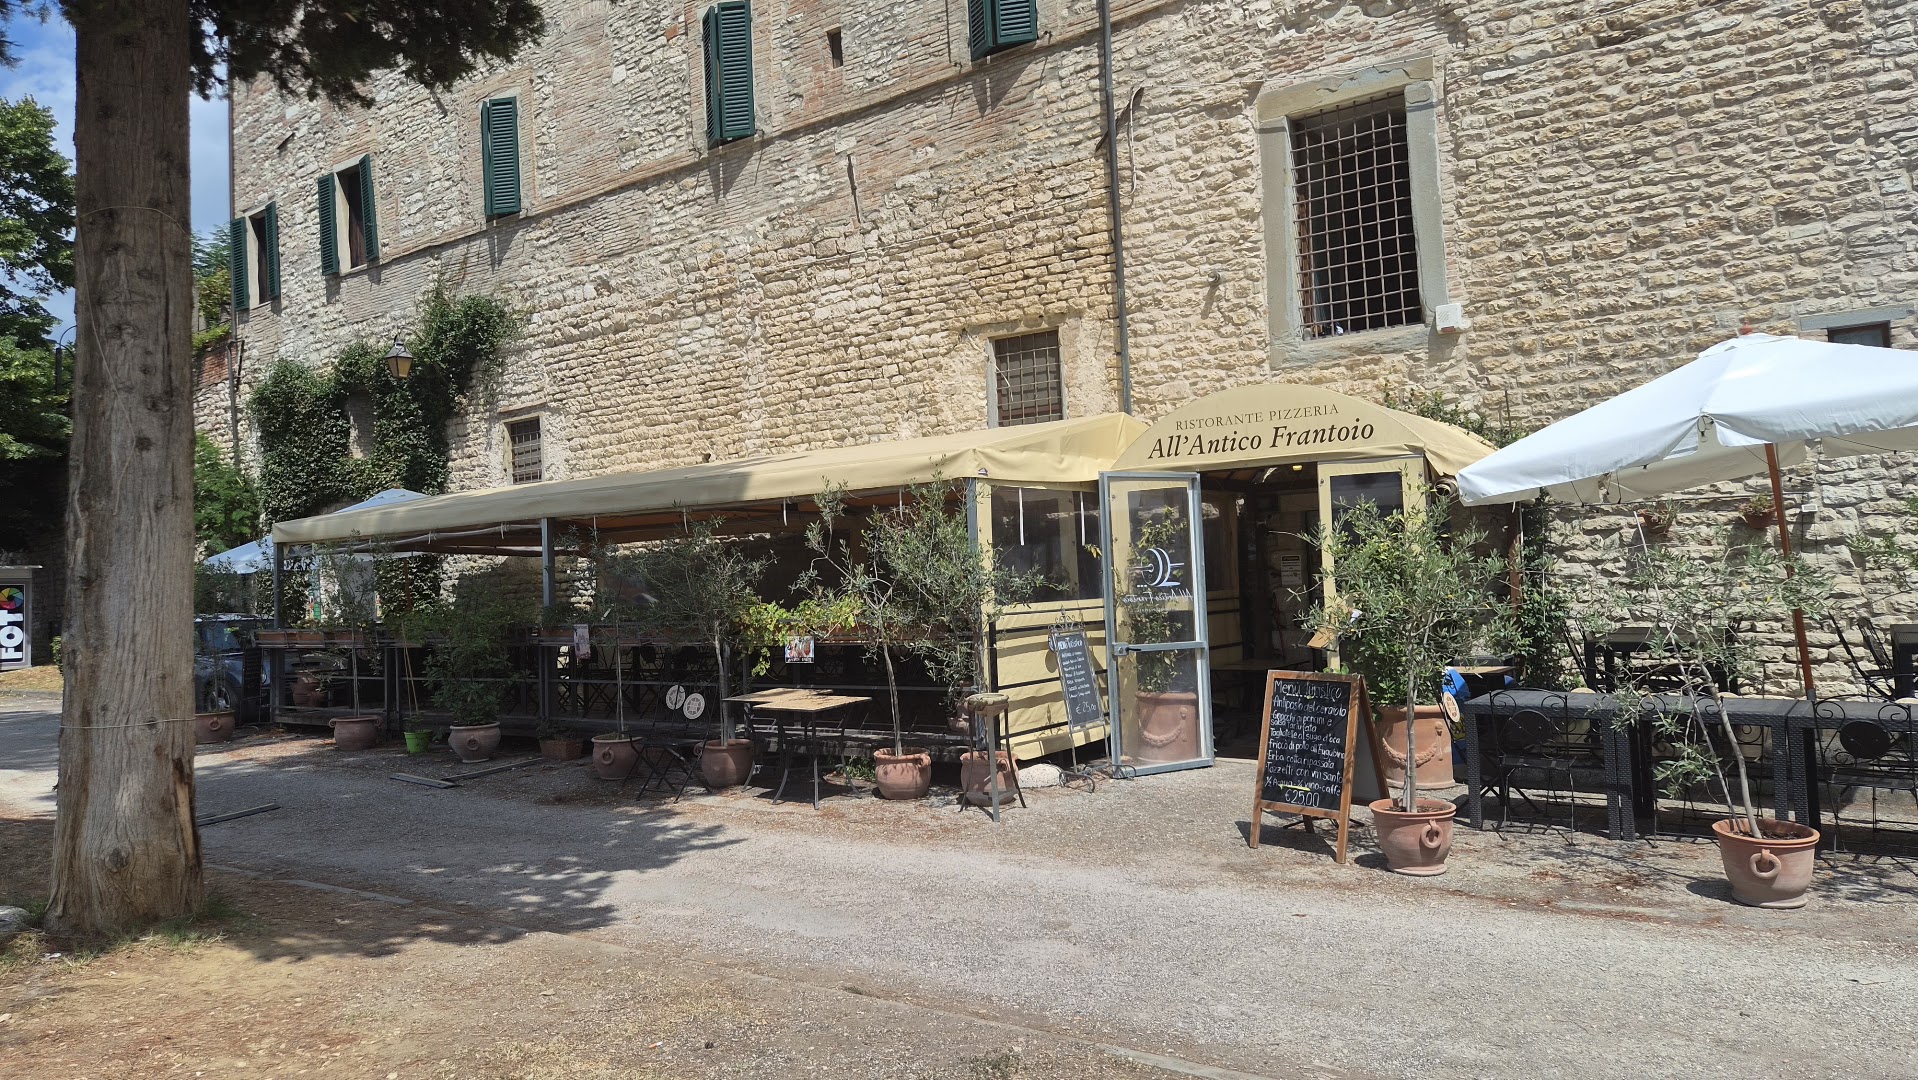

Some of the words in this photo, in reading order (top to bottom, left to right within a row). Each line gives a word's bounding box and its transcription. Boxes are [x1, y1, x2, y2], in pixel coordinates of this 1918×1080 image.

[1176, 411, 1264, 430] RISTORANTE
[1269, 403, 1339, 421] PIZZERIA
[1148, 430, 1262, 459] All'Antico
[1270, 417, 1374, 448] Frantoio
